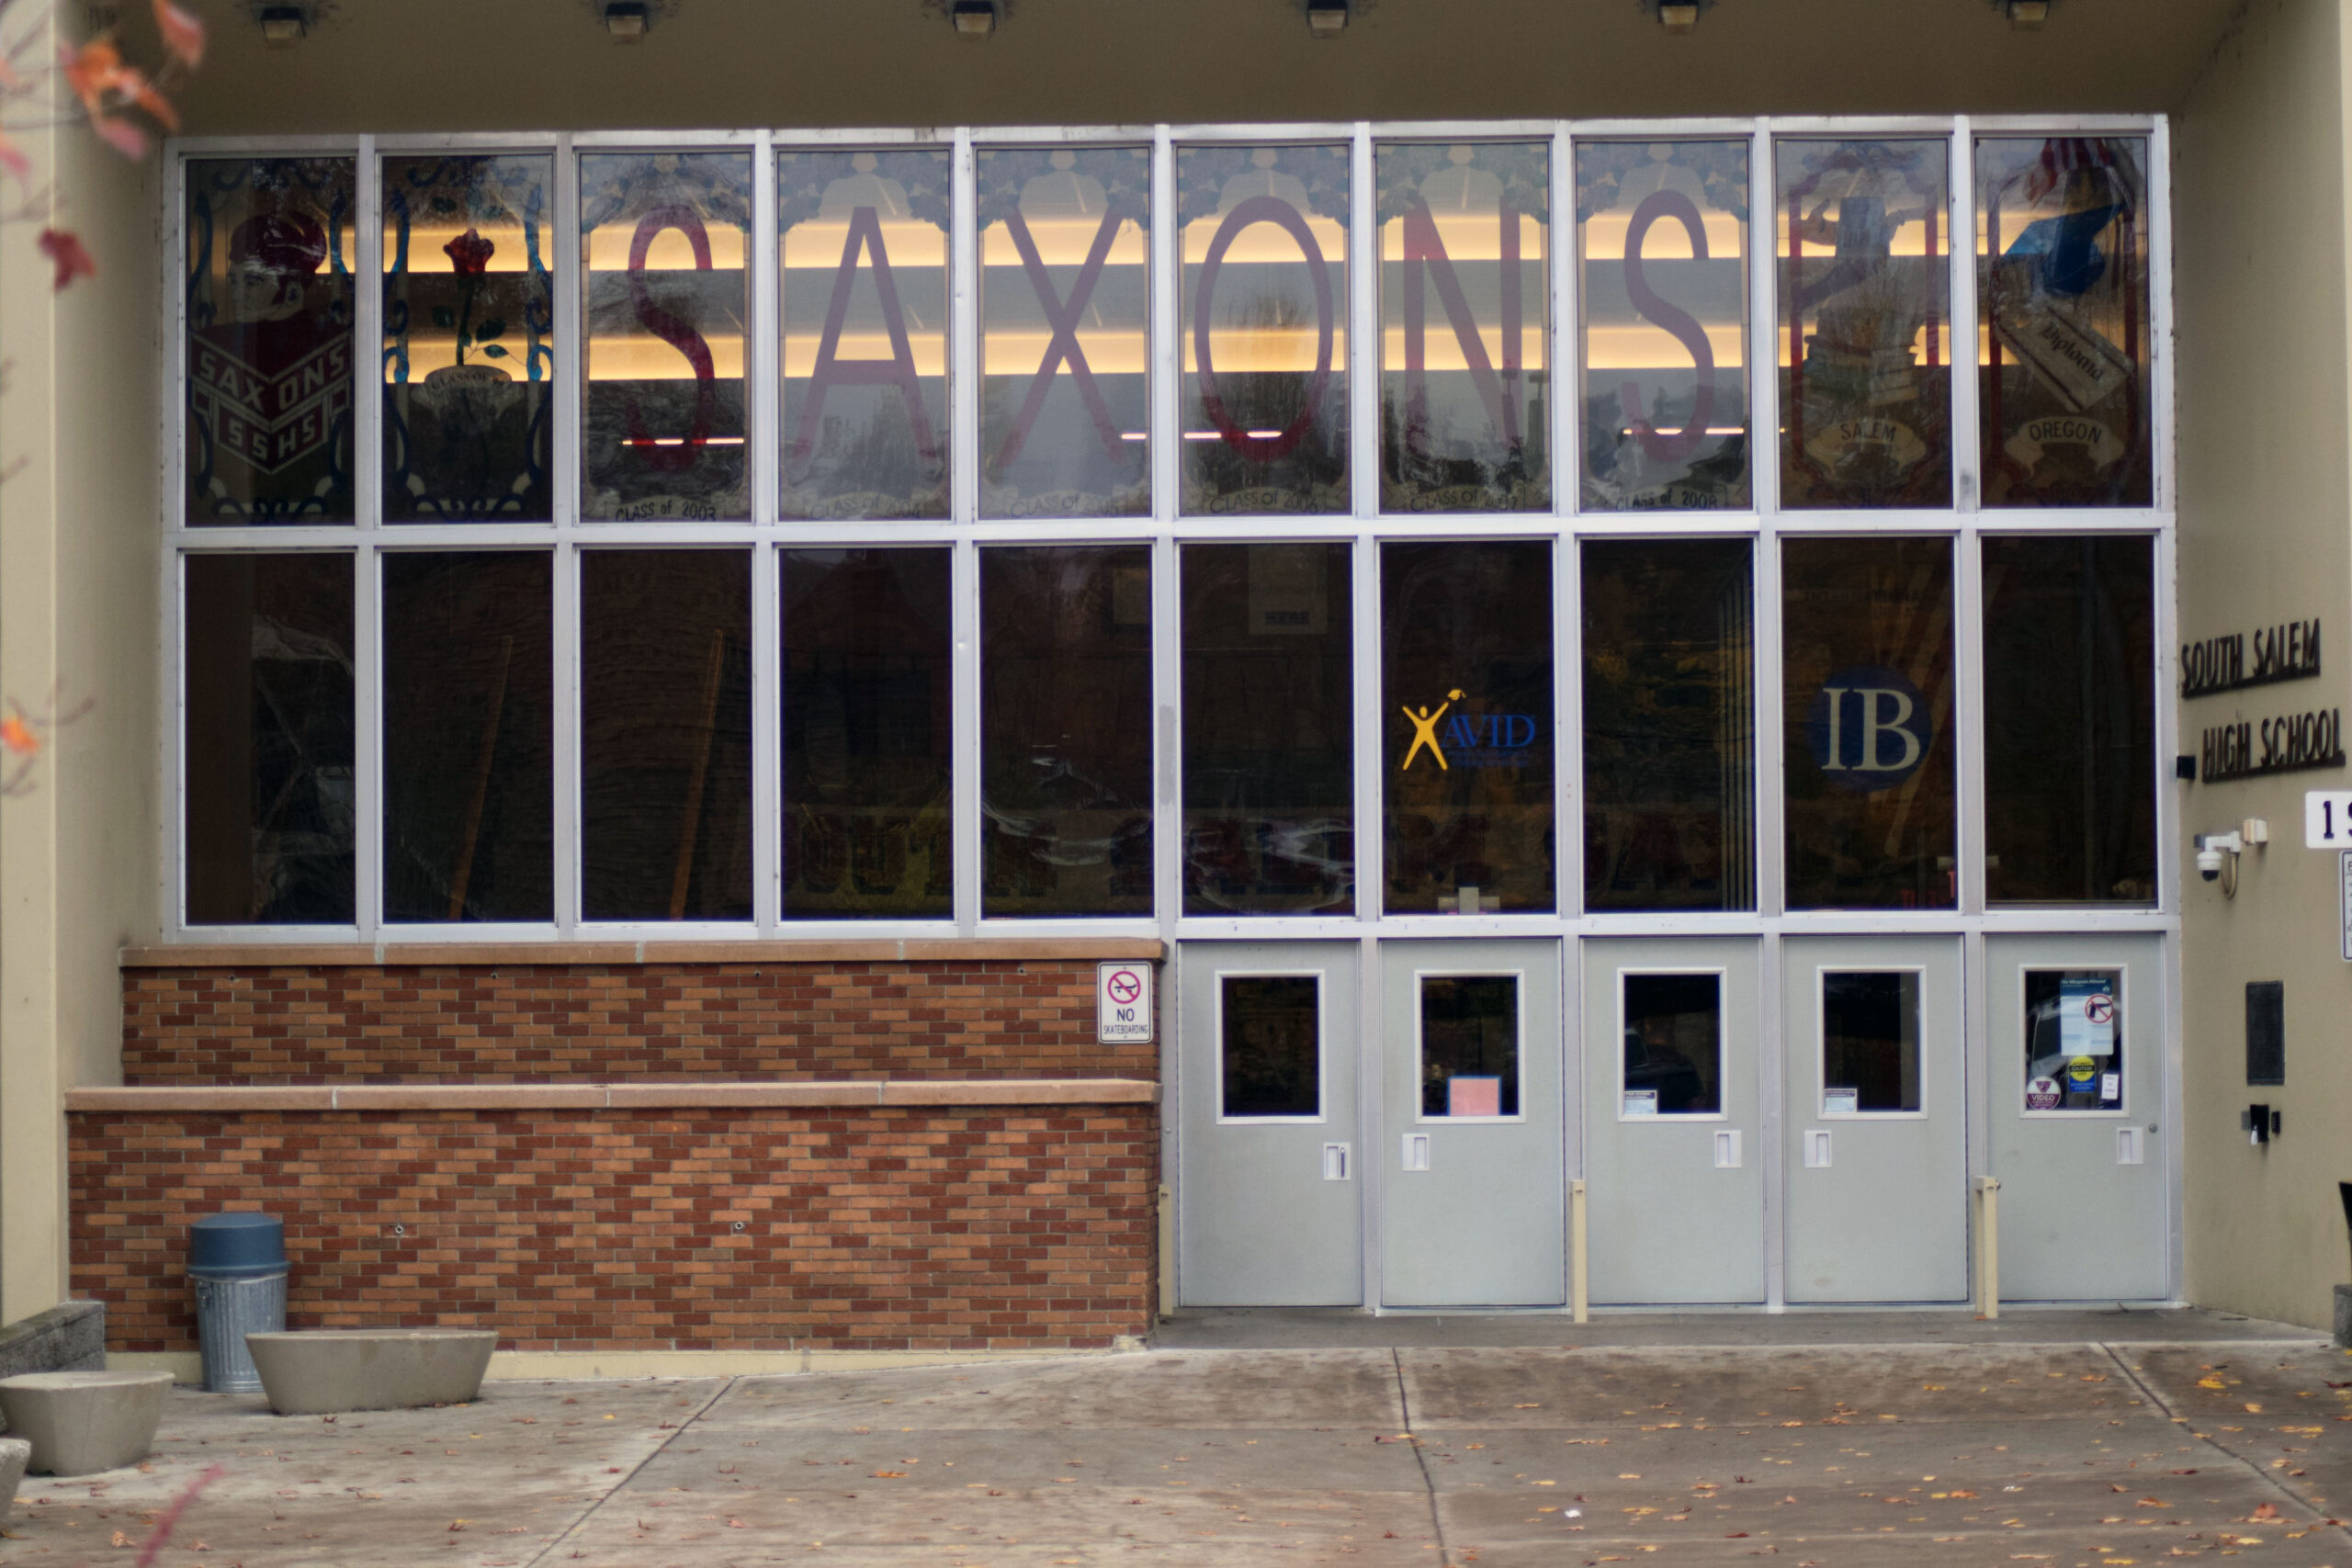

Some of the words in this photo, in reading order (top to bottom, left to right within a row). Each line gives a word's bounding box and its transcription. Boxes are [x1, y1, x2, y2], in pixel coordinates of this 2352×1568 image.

[199, 344, 345, 413] SAXONS
[228, 413, 315, 460] SSHS
[1839, 418, 1896, 442] SALEM
[2029, 420, 2102, 445] OREGON
[615, 502, 654, 523] CLASS
[1209, 491, 1259, 514] CLASS
[2181, 634, 2243, 691] SOUTH
[2253, 617, 2321, 678] SALEM
[1440, 714, 1535, 748] AVID
[1821, 687, 1921, 772] IB
[2202, 722, 2251, 776] HIGH
[2260, 708, 2345, 768] SCHOOL
[1103, 1024, 1148, 1034] SKATEBOARDING
[1117, 1009, 1135, 1021] NO
